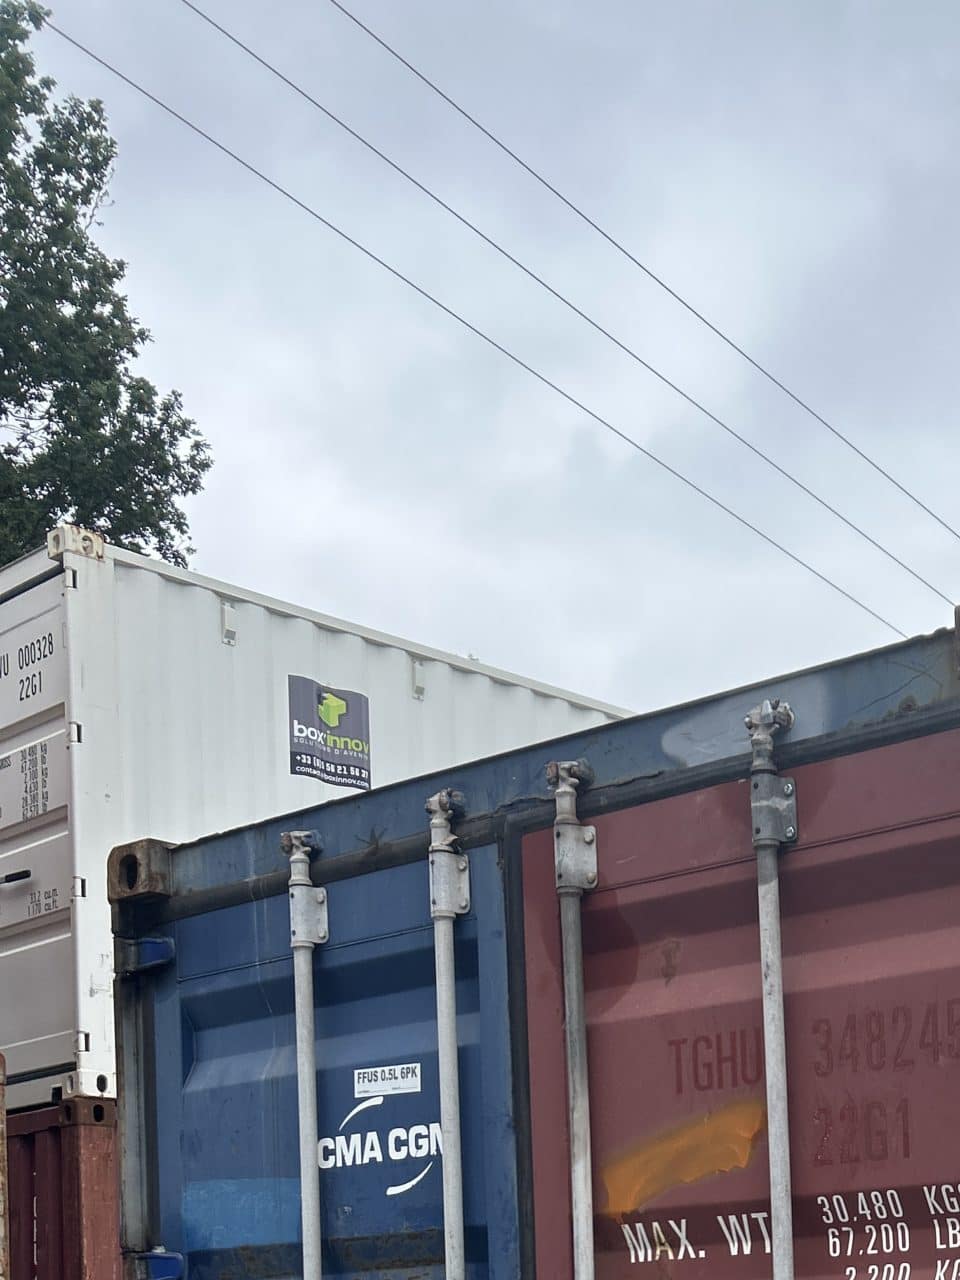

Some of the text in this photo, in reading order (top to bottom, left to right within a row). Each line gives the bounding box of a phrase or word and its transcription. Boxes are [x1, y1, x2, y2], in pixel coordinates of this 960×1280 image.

[18, 632, 54, 670] 000328
[19, 670, 42, 701] 22G1
[357, 1066, 418, 1084] FFUS 0.5L 6PK
[667, 1026, 765, 1095] TGHU
[318, 1131, 383, 1169] CMA
[812, 1098, 912, 1168] 22G1
[621, 1219, 706, 1263] MAX.
